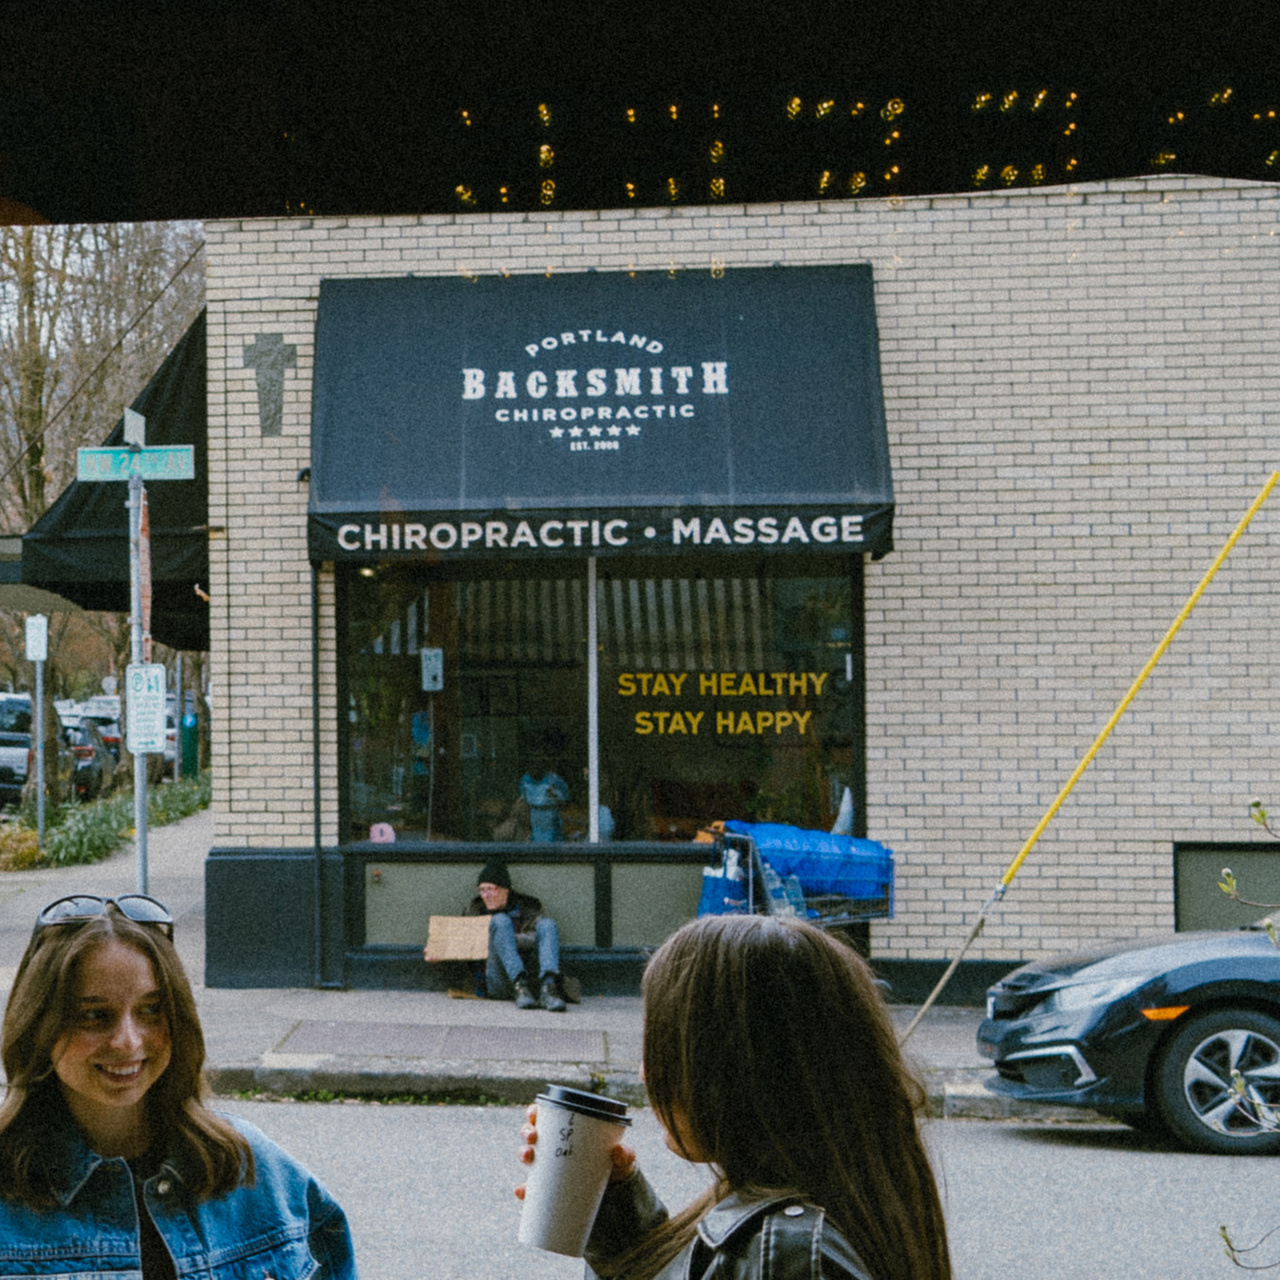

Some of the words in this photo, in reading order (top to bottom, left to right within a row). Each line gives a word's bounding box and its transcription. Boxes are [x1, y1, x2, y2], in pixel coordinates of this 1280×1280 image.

[524, 329, 664, 358] PORTLAND
[461, 361, 730, 401] BACKSMITH
[494, 403, 696, 423] CHIROPRACTIC
[570, 441, 591, 452] EST.
[85, 453, 112, 475] NW
[166, 453, 187, 474] AV
[337, 519, 628, 550] CHIROPRACTIC
[672, 515, 864, 544] MASSAGE
[618, 672, 688, 697] STAY
[698, 671, 829, 697] HEALTHY
[634, 710, 704, 736] STAY
[715, 709, 813, 735] HAPPY
